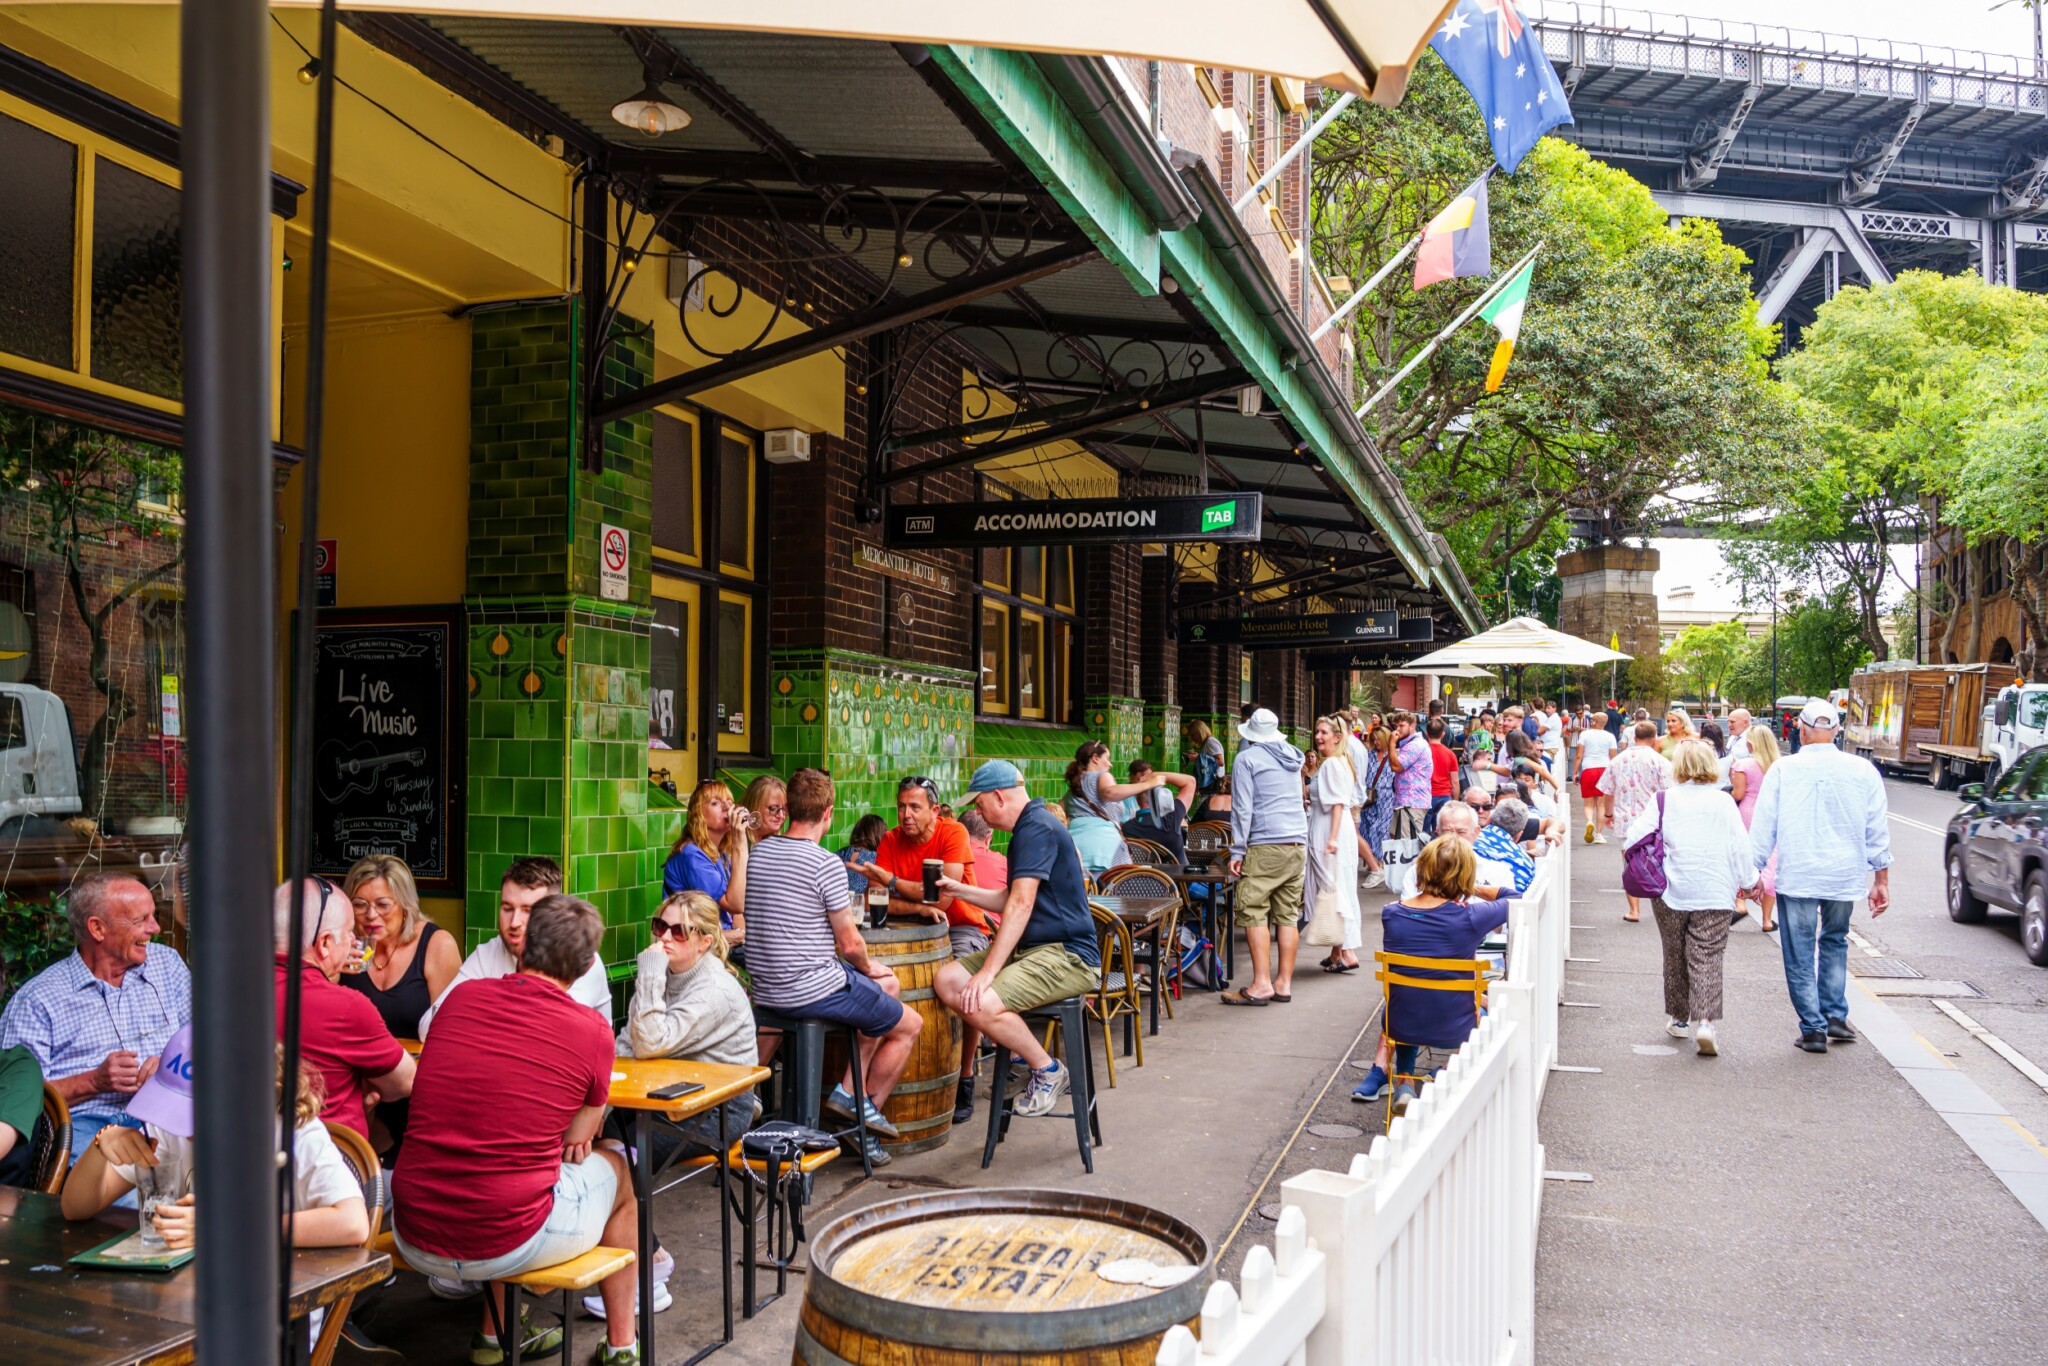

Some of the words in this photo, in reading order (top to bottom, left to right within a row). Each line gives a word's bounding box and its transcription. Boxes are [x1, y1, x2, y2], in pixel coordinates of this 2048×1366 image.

[909, 518, 931, 530] ATM
[974, 510, 1157, 531] ACCOMMODATION
[1206, 510, 1232, 523] TAB
[862, 544, 910, 574] MERCANTILE
[912, 561, 936, 582] HOTEL
[609, 572, 627, 581] SMOKING
[1240, 619, 1297, 632] Mercantile
[1299, 618, 1329, 629] Hotel
[1355, 626, 1386, 635] GUINNESS
[338, 668, 394, 703] Live
[349, 705, 418, 736] Music
[384, 773, 434, 804] Thursday
[387, 800, 397, 814] to
[399, 797, 436, 824] Sunday
[349, 821, 370, 829] LOCAL
[373, 821, 400, 829] ARTIST
